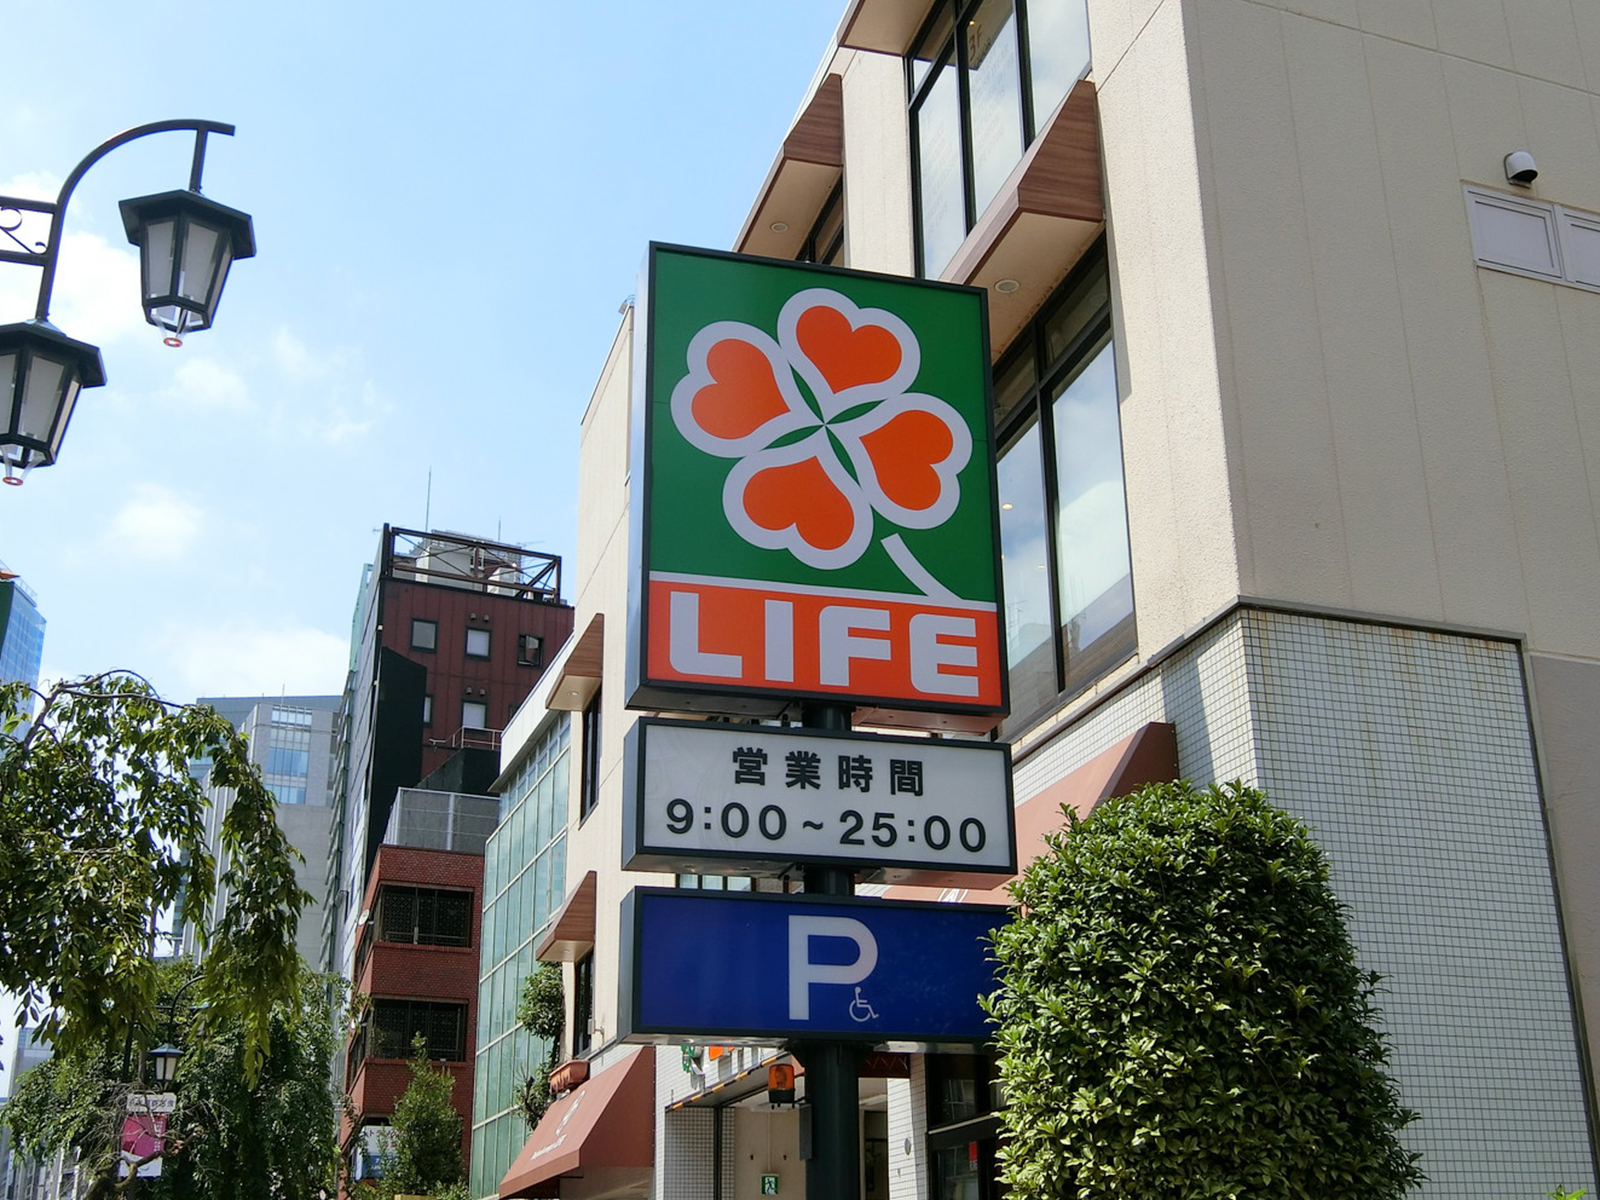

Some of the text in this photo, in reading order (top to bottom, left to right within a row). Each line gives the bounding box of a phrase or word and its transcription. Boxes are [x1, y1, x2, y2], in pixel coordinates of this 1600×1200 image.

[669, 590, 979, 697] LIFE
[732, 747, 923, 797] 営業時間
[788, 915, 878, 1021] P
